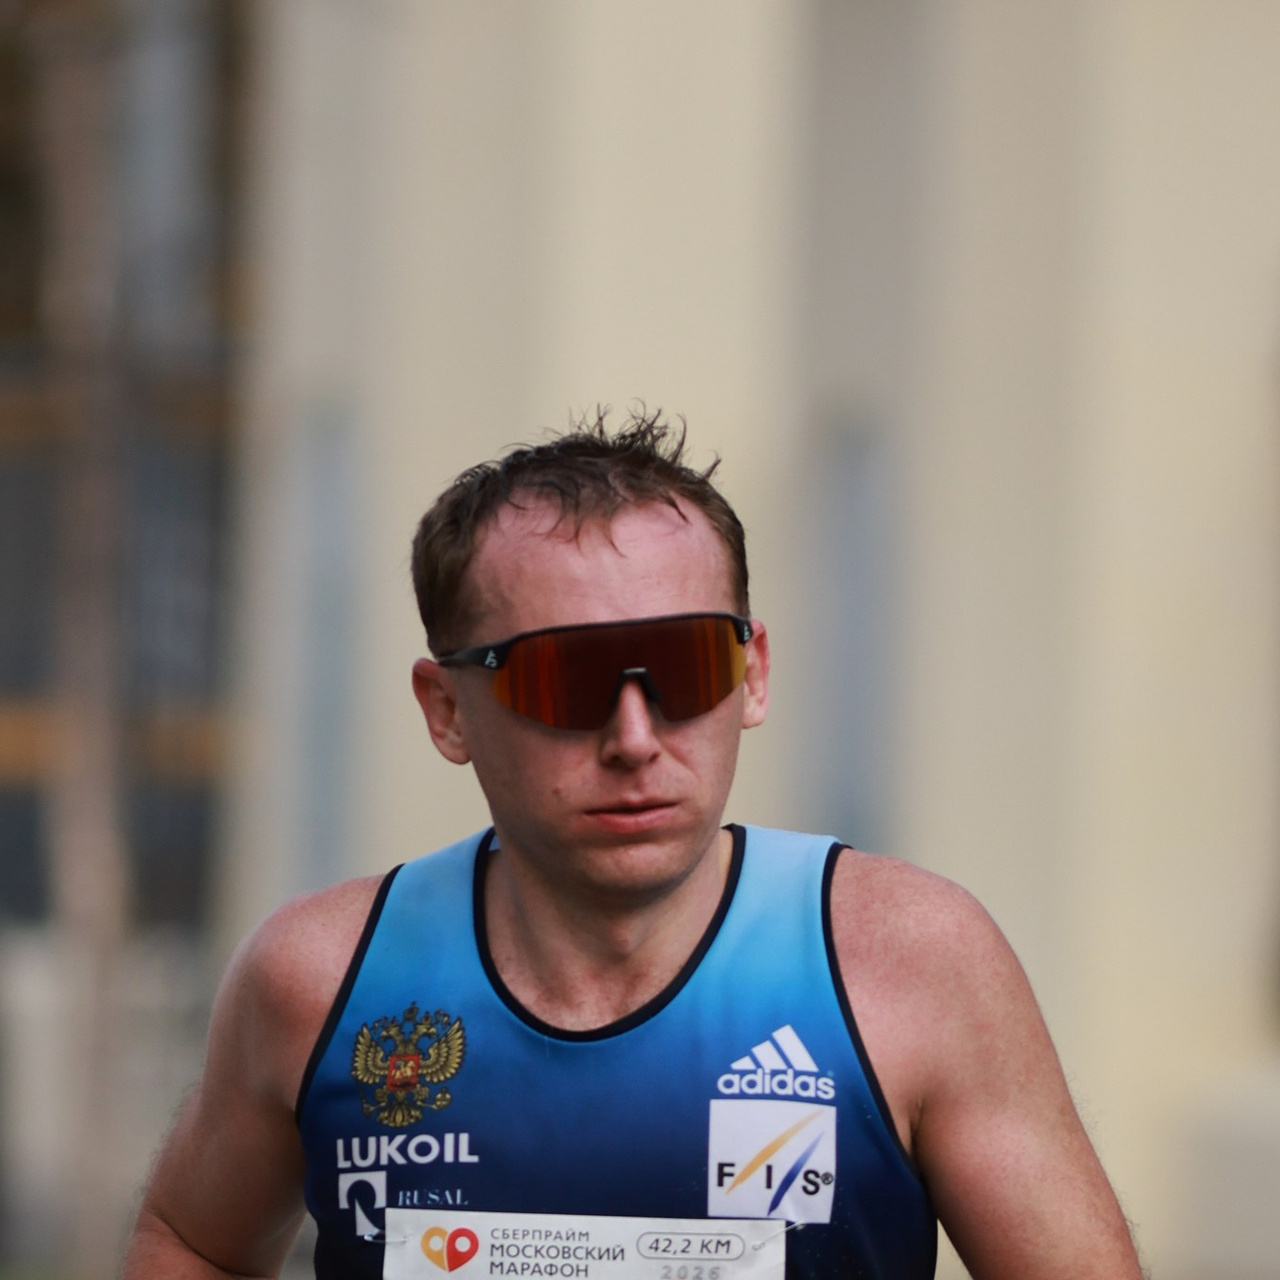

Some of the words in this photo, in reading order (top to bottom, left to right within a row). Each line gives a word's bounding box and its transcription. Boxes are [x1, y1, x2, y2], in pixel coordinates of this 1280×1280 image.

[717, 1068, 835, 1100] adidas
[336, 1132, 479, 1168] LUKOIL
[398, 1189, 468, 1206] RUSAL
[490, 1228, 590, 1242] СБЕРПРАЙМ
[489, 1243, 626, 1262] МОСКОВСКИЙ
[648, 1238, 692, 1256] 42,2
[489, 1261, 589, 1278] МАРАФОН
